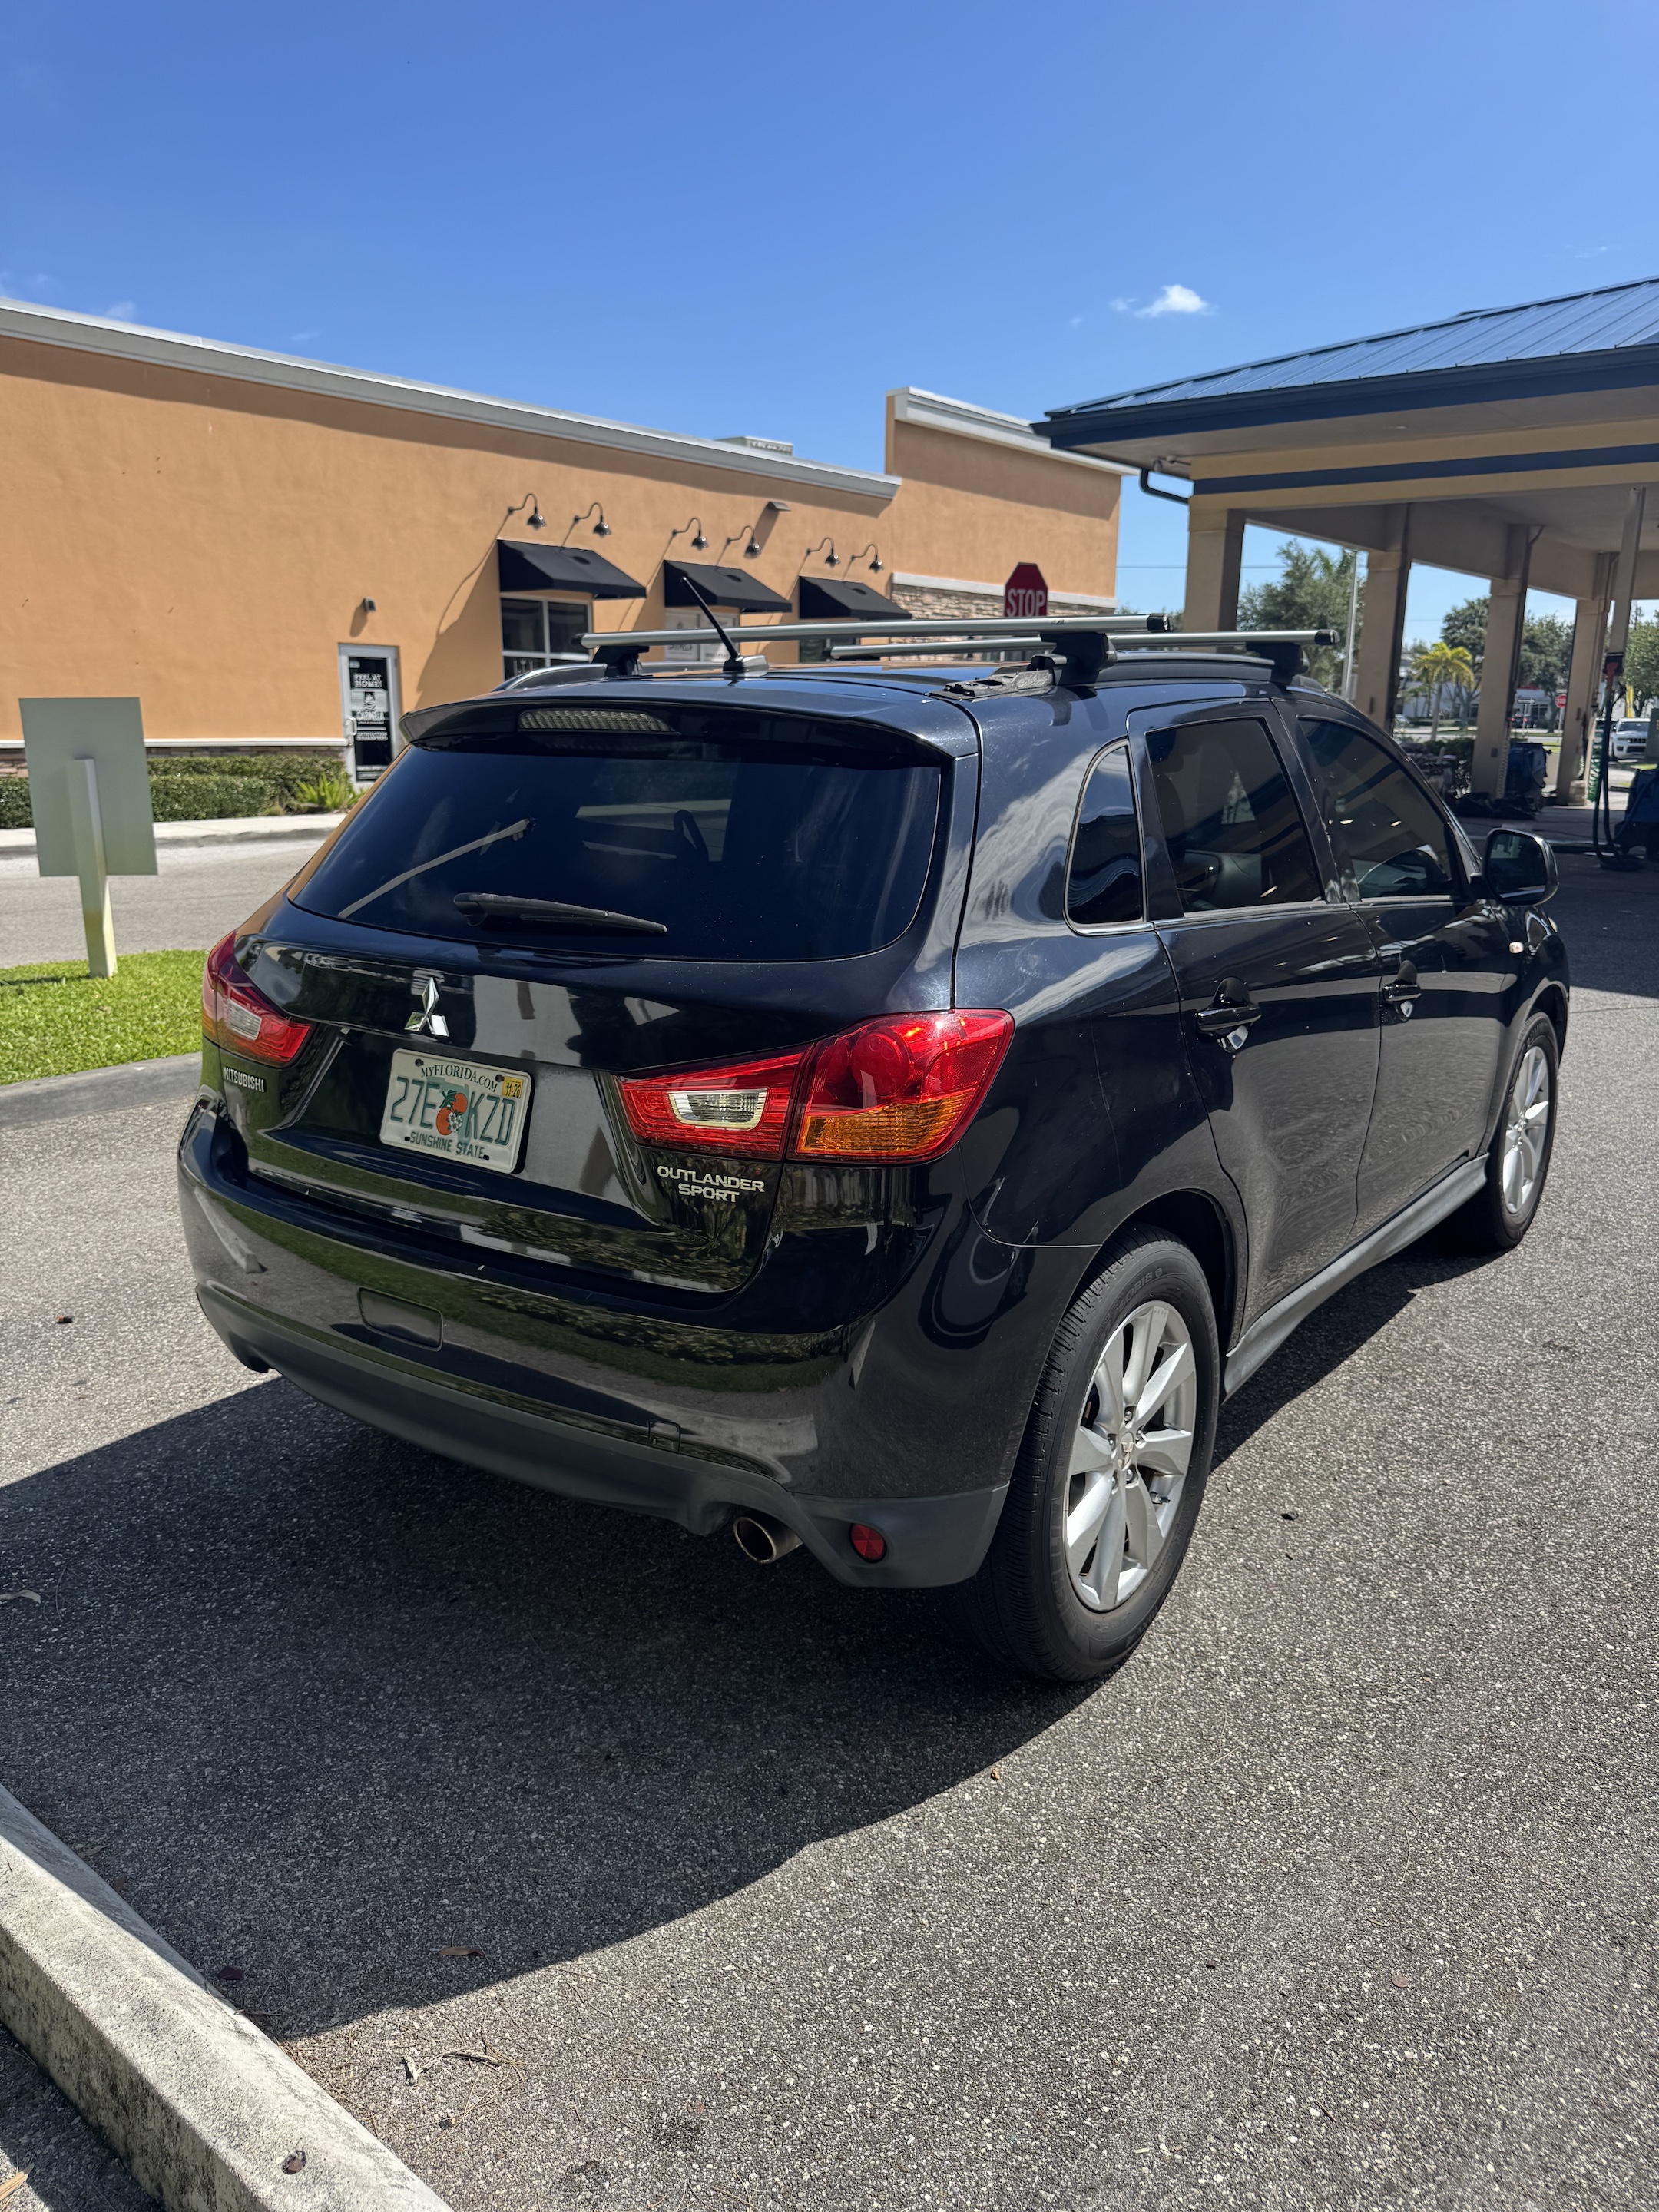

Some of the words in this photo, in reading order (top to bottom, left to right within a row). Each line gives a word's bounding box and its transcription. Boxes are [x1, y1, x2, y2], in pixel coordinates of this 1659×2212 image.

[1006, 588, 1046, 617] STOP
[224, 1066, 265, 1093] MITSUBISHI
[421, 1064, 498, 1093] MYFLORIDA.COM
[506, 1083, 522, 1098] 11-26
[390, 1076, 440, 1129] 27E
[464, 1091, 515, 1147] KZD
[409, 1131, 453, 1153] SUNSHINE
[455, 1142, 485, 1159] STATE
[657, 1165, 766, 1193] OUTLANDER
[677, 1183, 740, 1203] SPORT
